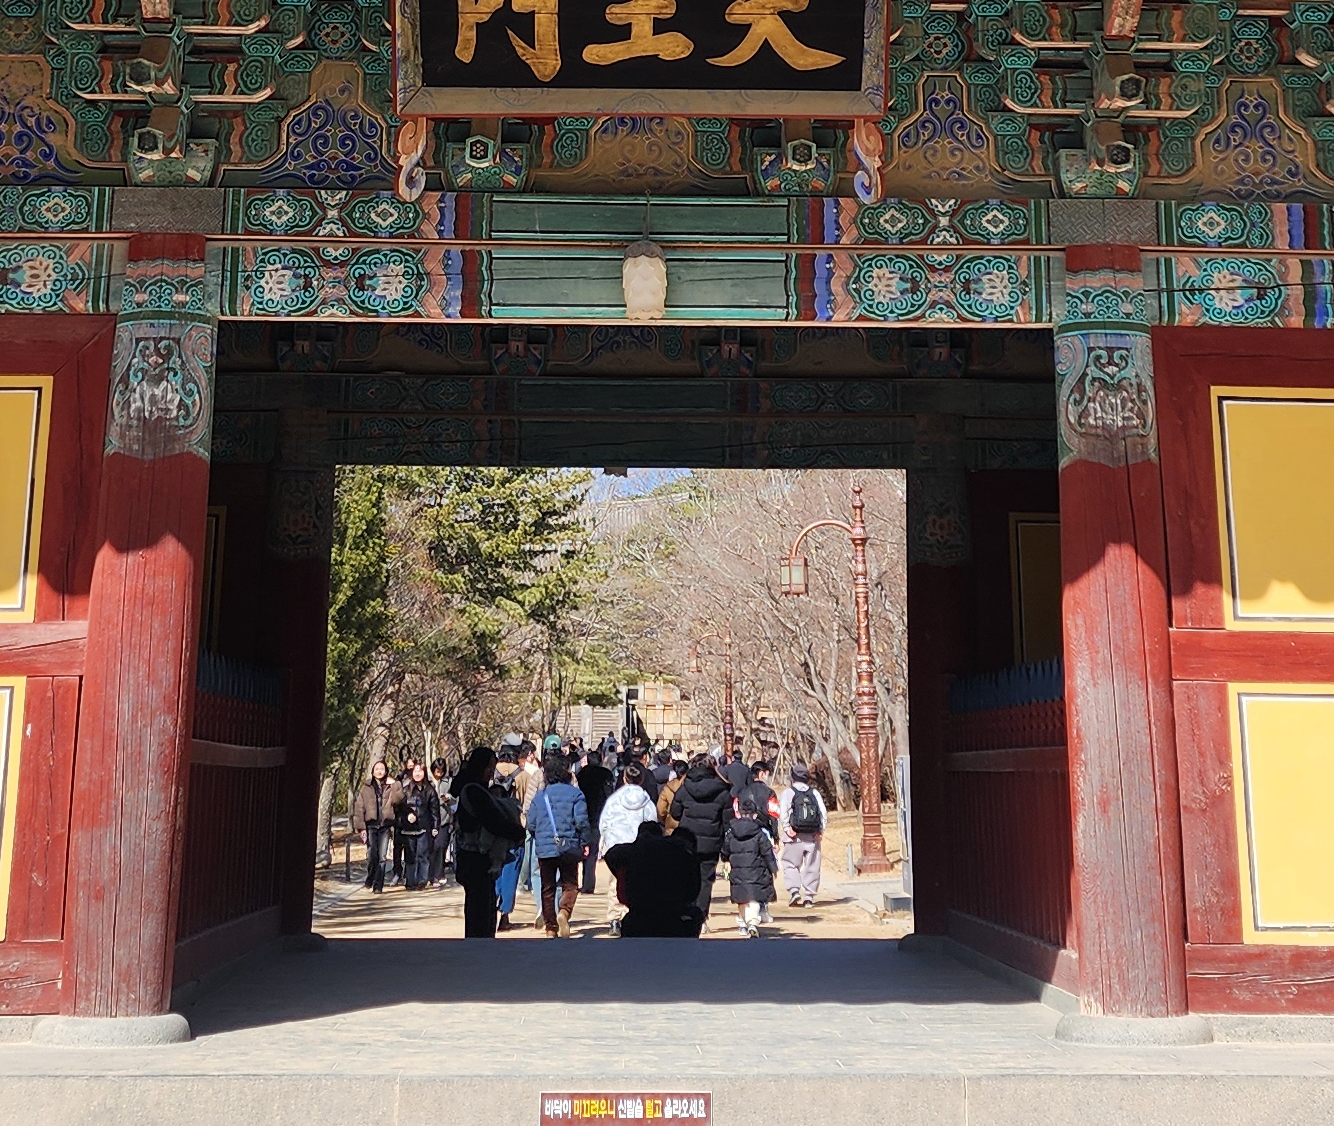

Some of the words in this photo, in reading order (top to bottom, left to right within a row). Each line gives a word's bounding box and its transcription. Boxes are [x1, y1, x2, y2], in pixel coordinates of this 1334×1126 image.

[544, 1098, 571, 1119] 바닥이
[617, 1097, 644, 1119] 신발을
[645, 1098, 663, 1119] 털고
[664, 1097, 707, 1119] 올라오세요
